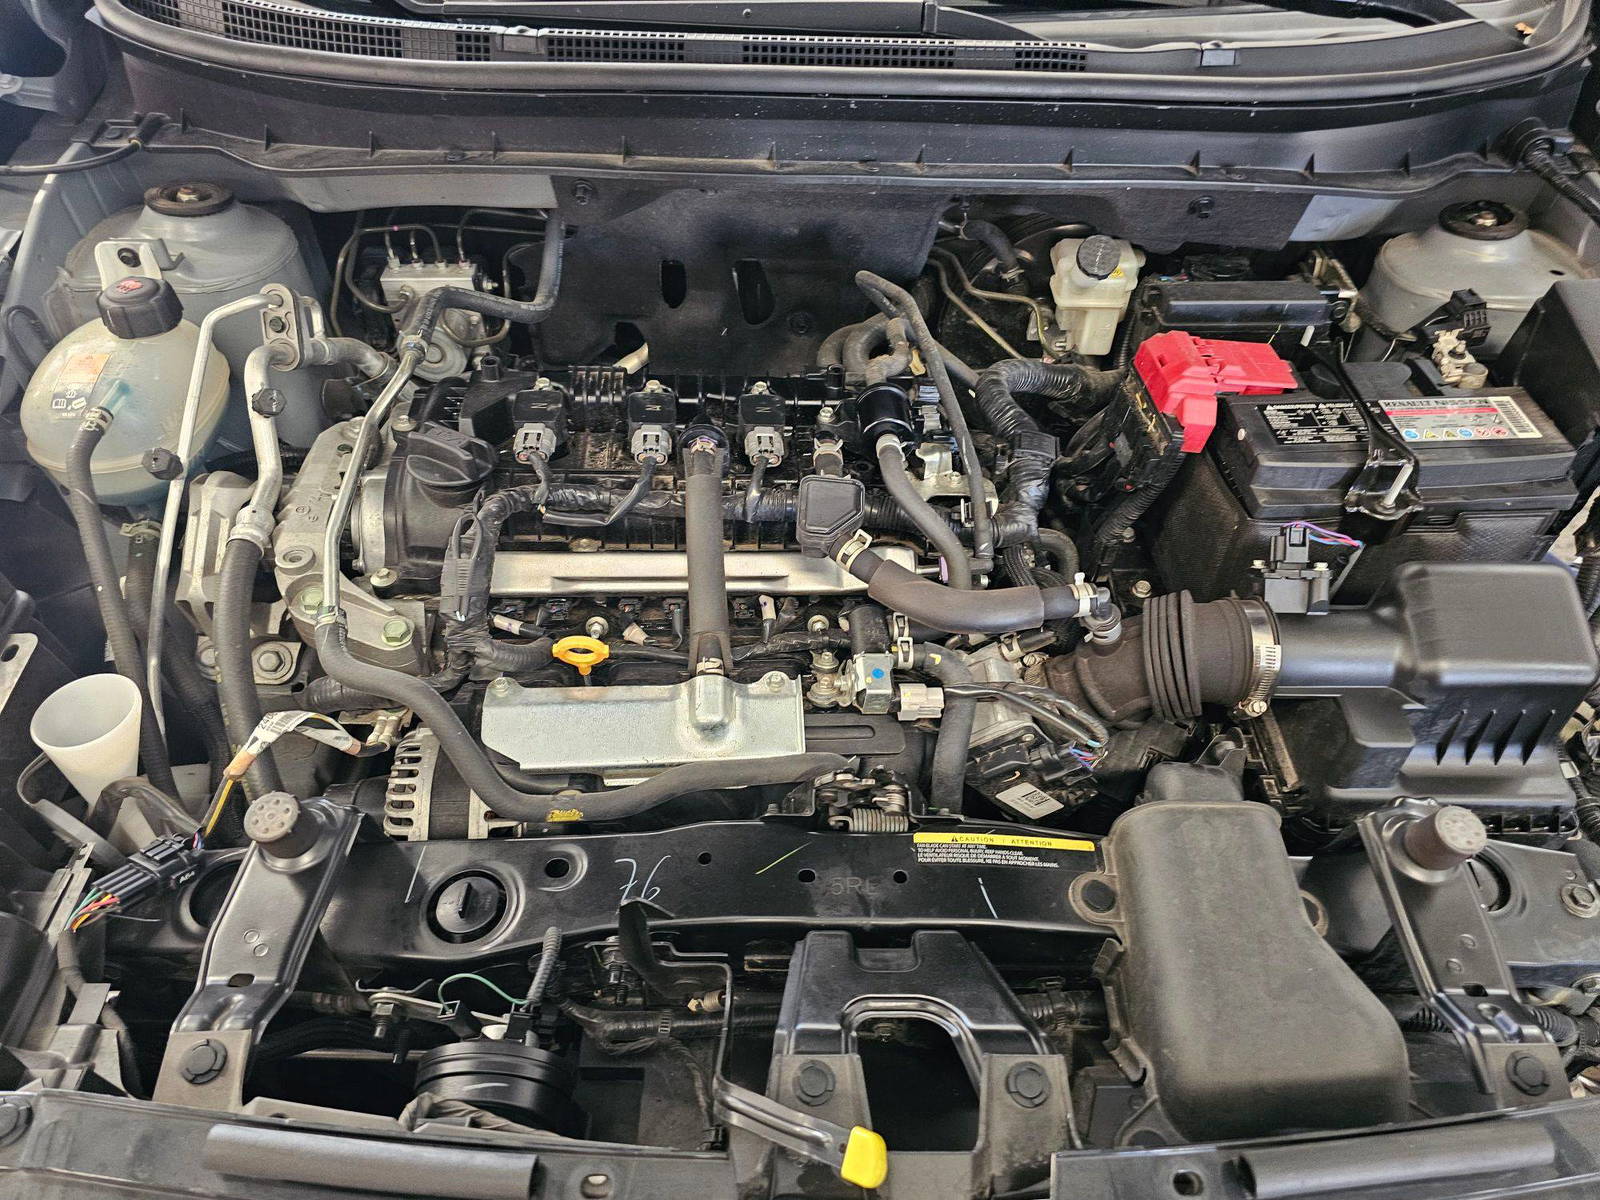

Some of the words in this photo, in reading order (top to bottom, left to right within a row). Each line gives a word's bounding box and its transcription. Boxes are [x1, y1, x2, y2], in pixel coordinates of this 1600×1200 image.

[1382, 400, 1430, 408] RENAULT
[1011, 839, 1052, 847] ATTENTION
[614, 855, 672, 909] 76
